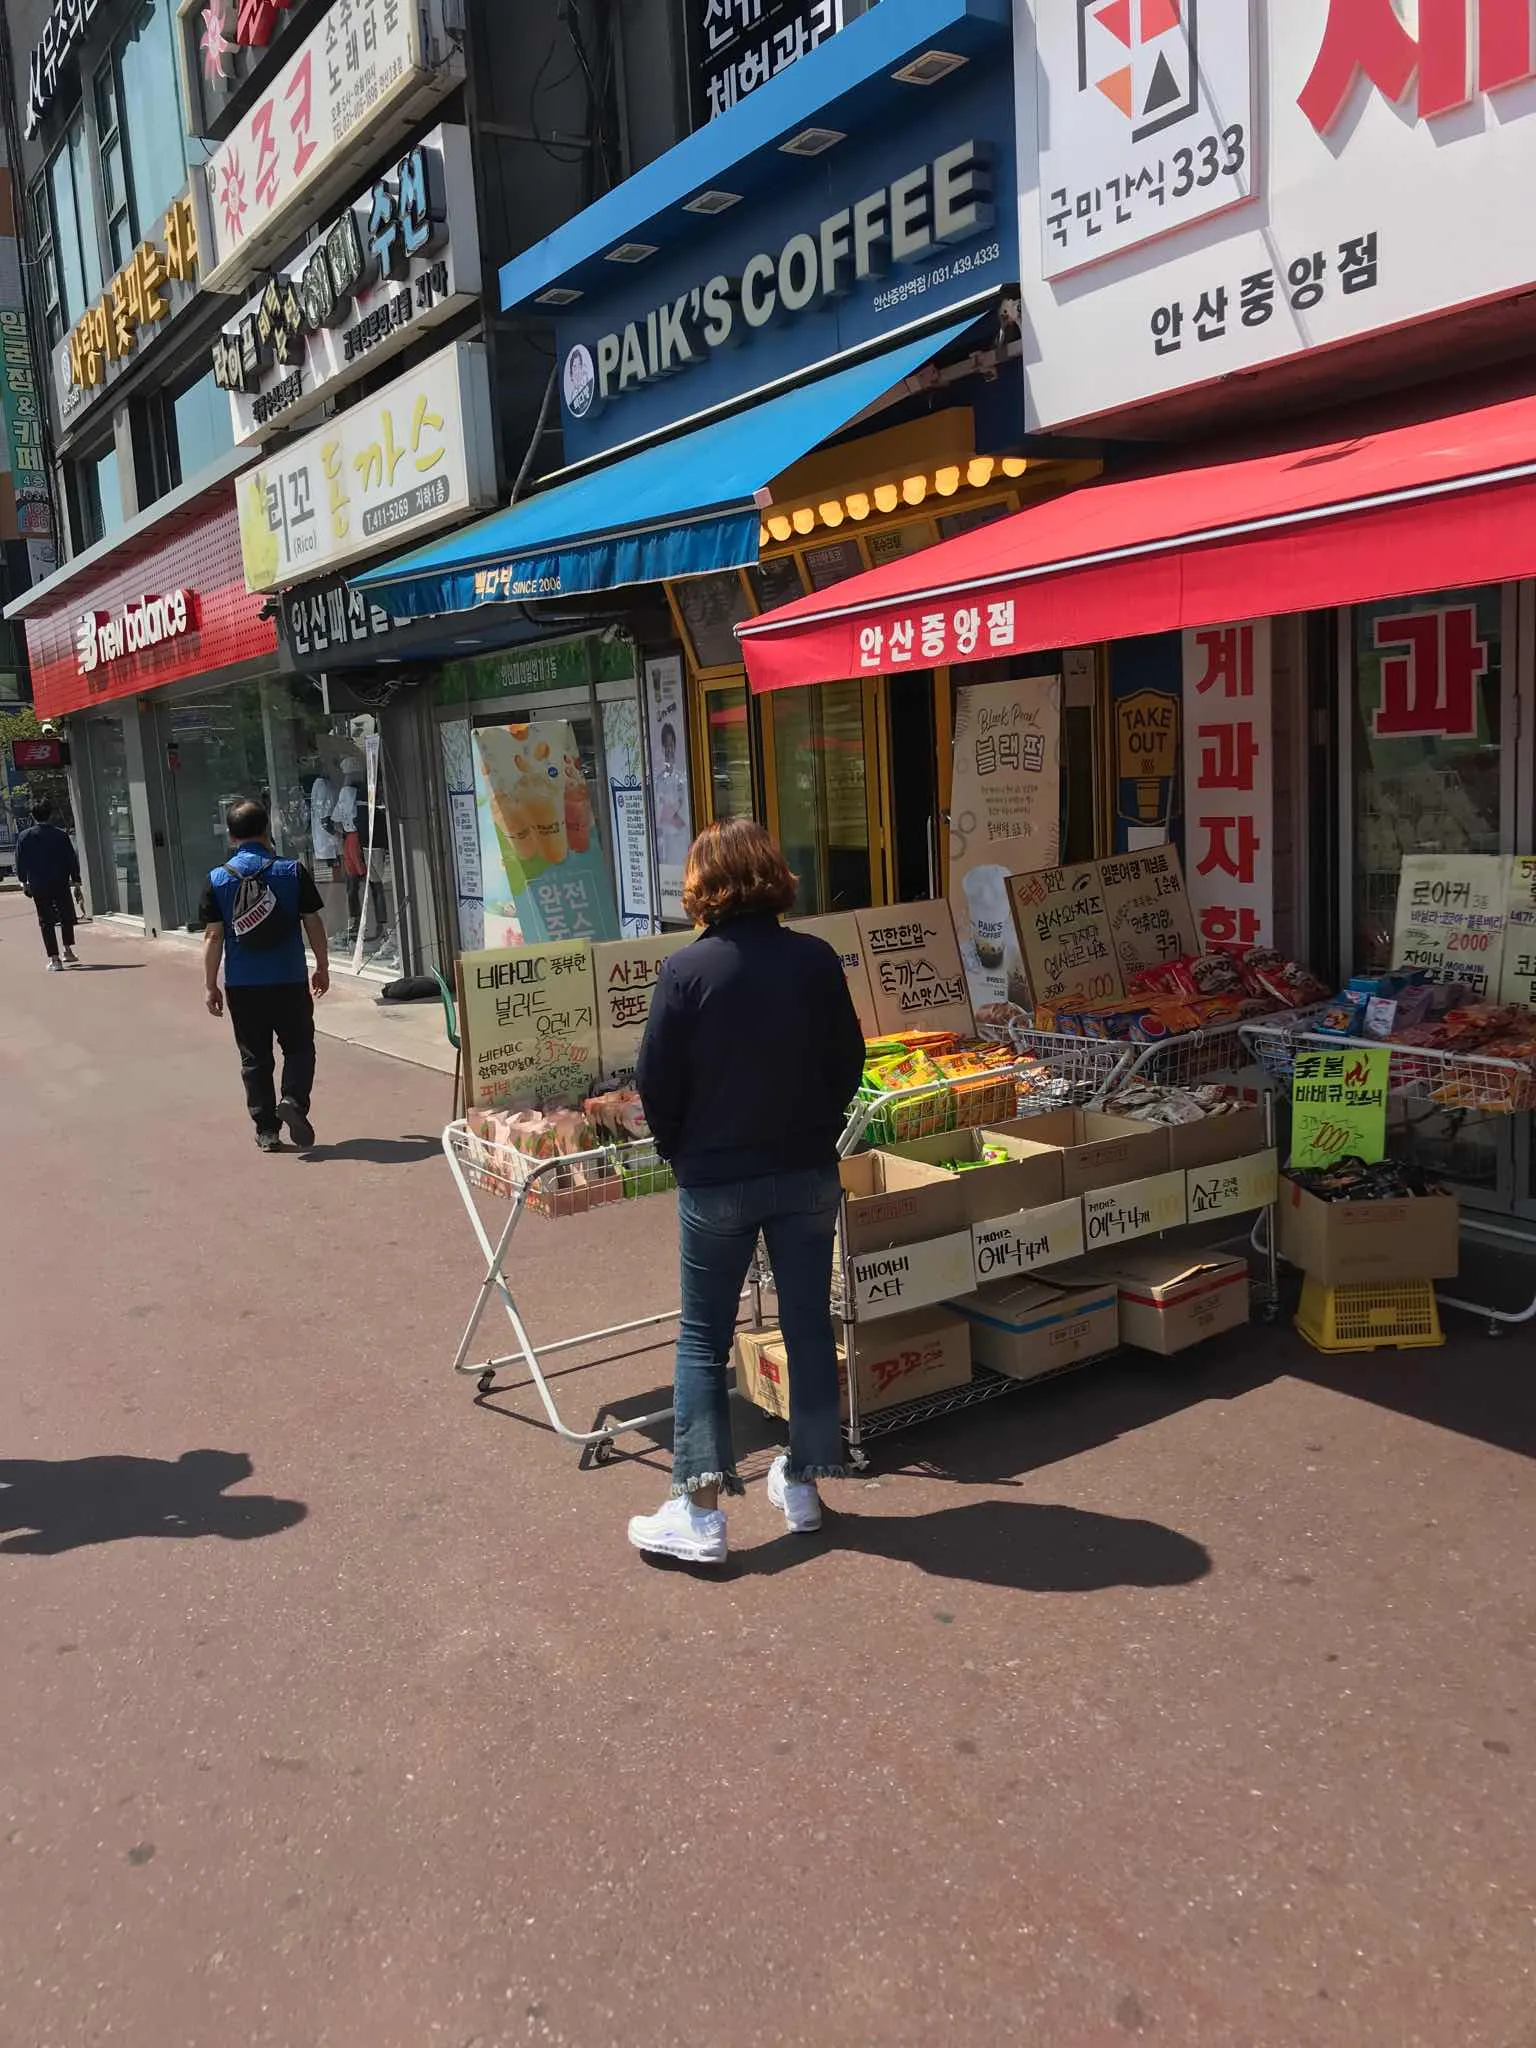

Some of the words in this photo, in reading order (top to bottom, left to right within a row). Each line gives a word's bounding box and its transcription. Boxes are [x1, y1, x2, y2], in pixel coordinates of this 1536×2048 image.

[598, 273, 732, 399] PAIK'S
[741, 139, 974, 328] COFFEE
[873, 275, 927, 314] 안산중앙역점
[932, 243, 1000, 286] 031.439.4333
[1151, 231, 1379, 357] 안산중앙점
[70, 293, 111, 390] 사랑이
[111, 240, 169, 355] 꽃피는
[321, 394, 445, 539] 돈까스
[512, 579, 538, 595] SINCE
[538, 576, 562, 593] 2006
[98, 620, 125, 664] new
[125, 588, 188, 654] balance
[859, 597, 1016, 670] 안산중앙점
[1374, 603, 1488, 740] 과
[1122, 706, 1173, 732] TAKE
[975, 734, 1046, 776] 블랙펄
[1128, 731, 1168, 754] OUT
[1411, 881, 1471, 908] 로아커
[1155, 933, 1182, 960] 쿠키
[1446, 932, 1489, 951] 2000
[477, 957, 548, 989] 비타민C
[550, 953, 587, 977] 풍부한
[880, 960, 936, 993] 돈까스
[495, 990, 552, 1028] 블러드
[536, 1006, 593, 1038] 오렌지
[1296, 1084, 1345, 1103] 바베큐
[856, 1255, 910, 1283] 베이비
[866, 1279, 905, 1303] 스타
